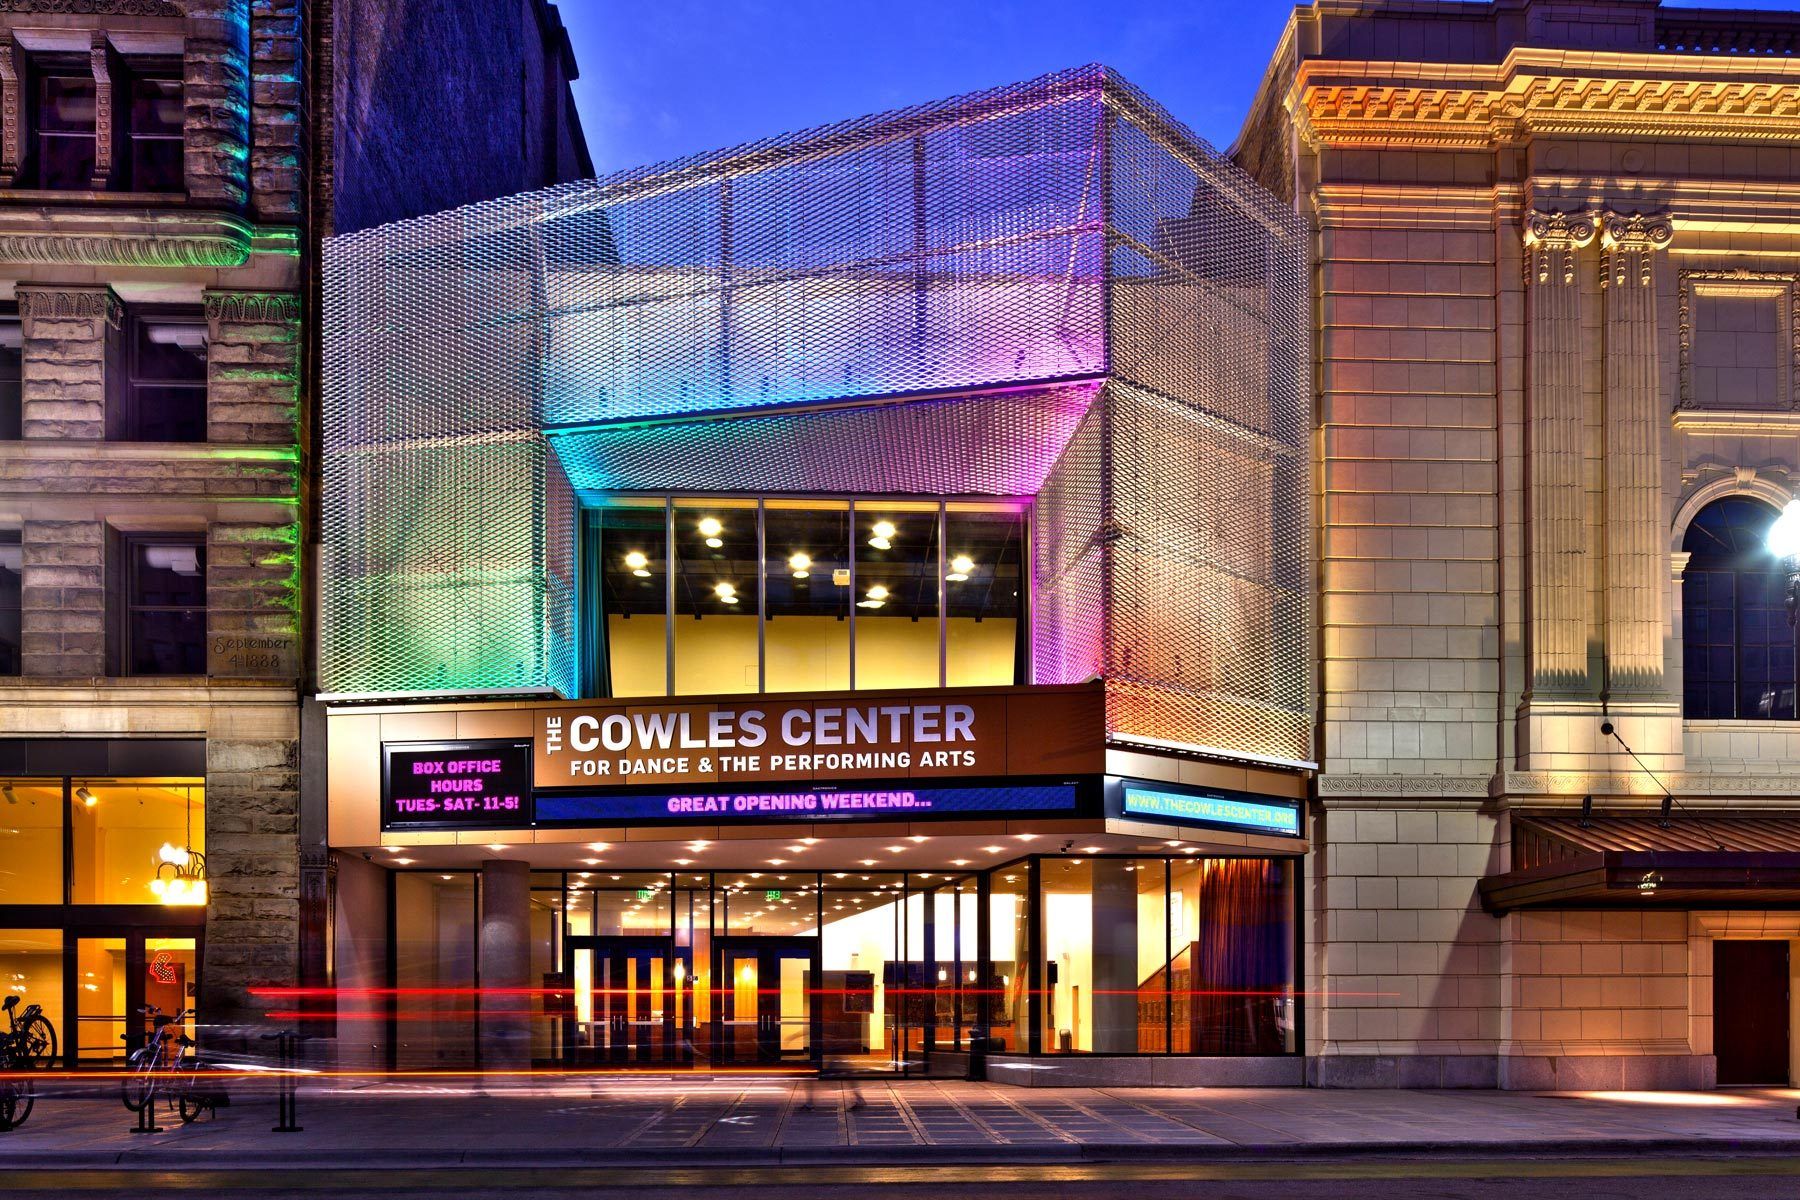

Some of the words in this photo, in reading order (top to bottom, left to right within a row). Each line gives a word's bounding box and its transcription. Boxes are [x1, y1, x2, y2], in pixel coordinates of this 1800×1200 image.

[214, 637, 291, 655] September
[546, 716, 562, 755] THE
[569, 711, 767, 753] COWLES
[781, 705, 977, 747] CENTER
[412, 761, 445, 775] BOX
[447, 760, 501, 774] OFFICE
[570, 759, 611, 776] FOR
[618, 757, 689, 775] DANCE
[697, 756, 714, 773] &
[718, 755, 761, 772] THE
[770, 751, 911, 771] PERFORMING
[919, 750, 976, 767] ARTS
[431, 778, 483, 793] HOURS
[396, 799, 441, 812] TUES-
[443, 797, 481, 811] SAT-
[667, 796, 730, 812] GREAT
[733, 794, 817, 811] OPENING
[820, 791, 932, 809] WEEKEND...
